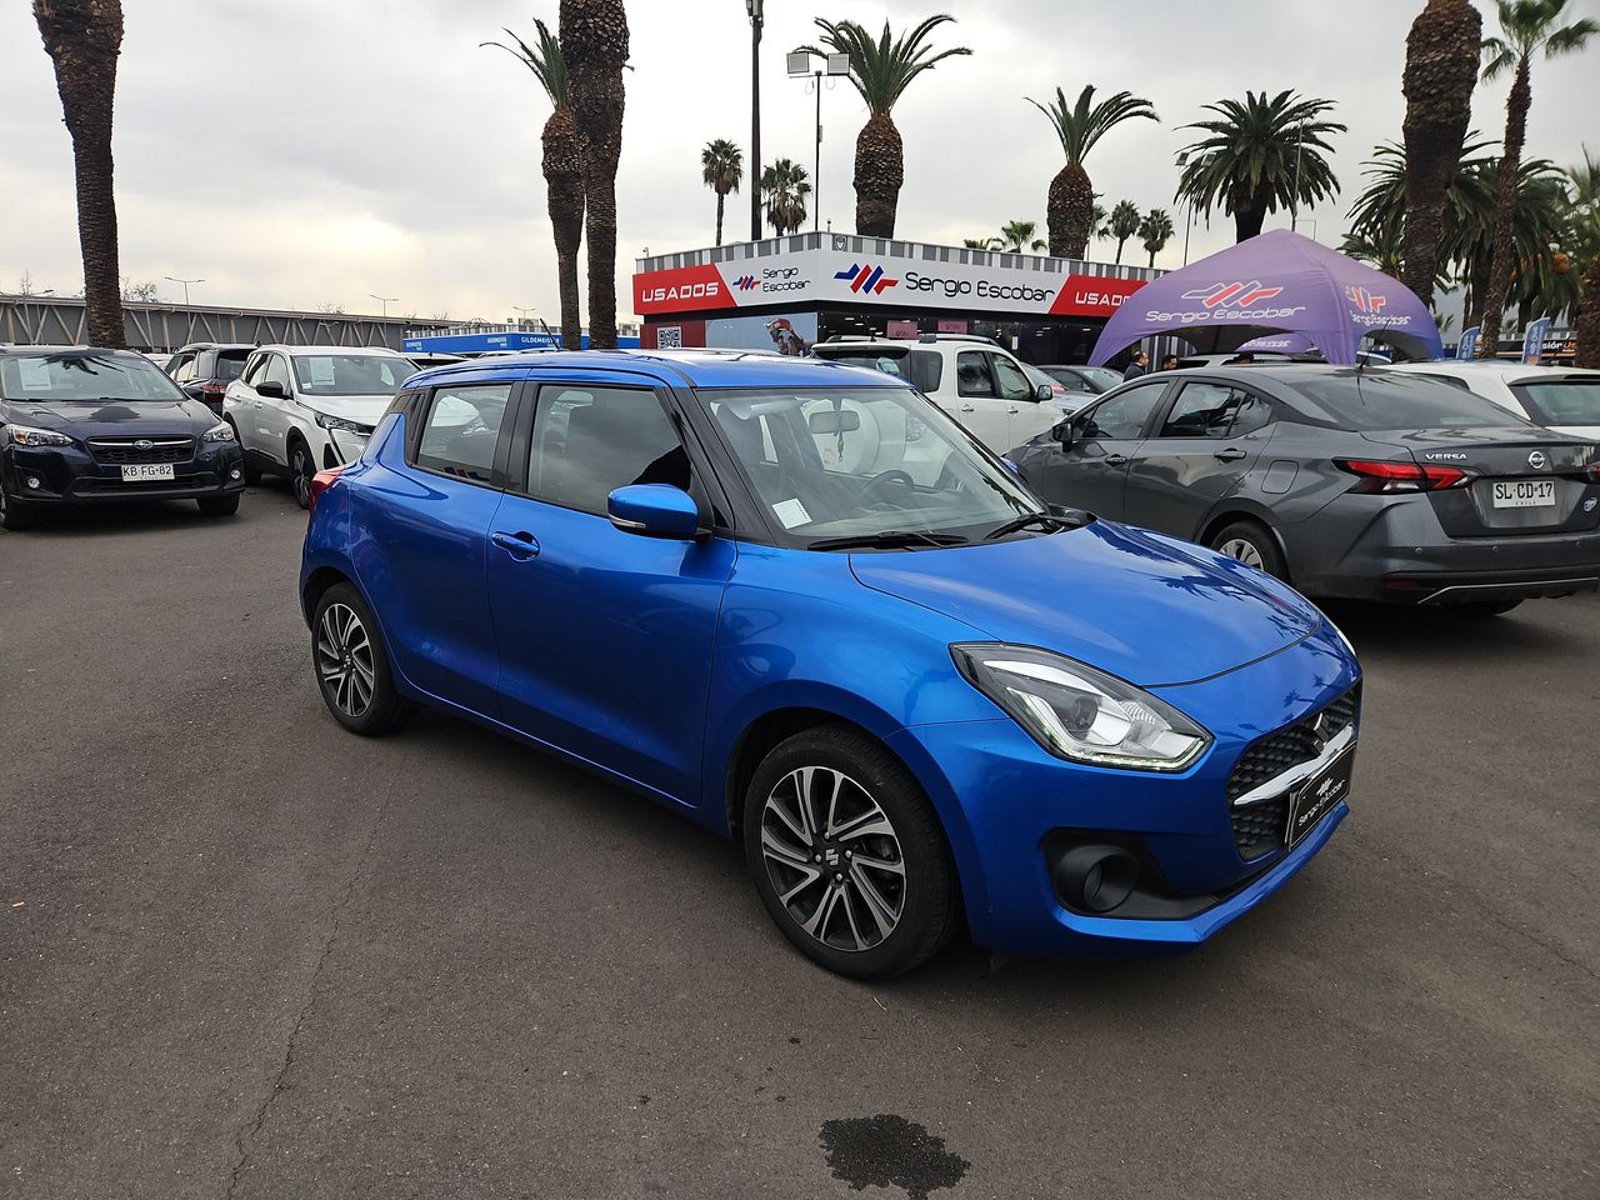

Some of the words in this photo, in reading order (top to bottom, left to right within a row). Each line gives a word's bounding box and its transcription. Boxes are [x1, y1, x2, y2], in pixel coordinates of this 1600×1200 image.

[762, 266, 799, 280] Sergio
[641, 281, 720, 303] USADOS
[762, 279, 811, 293] Escobar
[905, 271, 972, 298] Sergio
[977, 281, 1055, 302] Escobar
[1146, 310, 1211, 323] Sergio
[1213, 306, 1307, 320] Escobar
